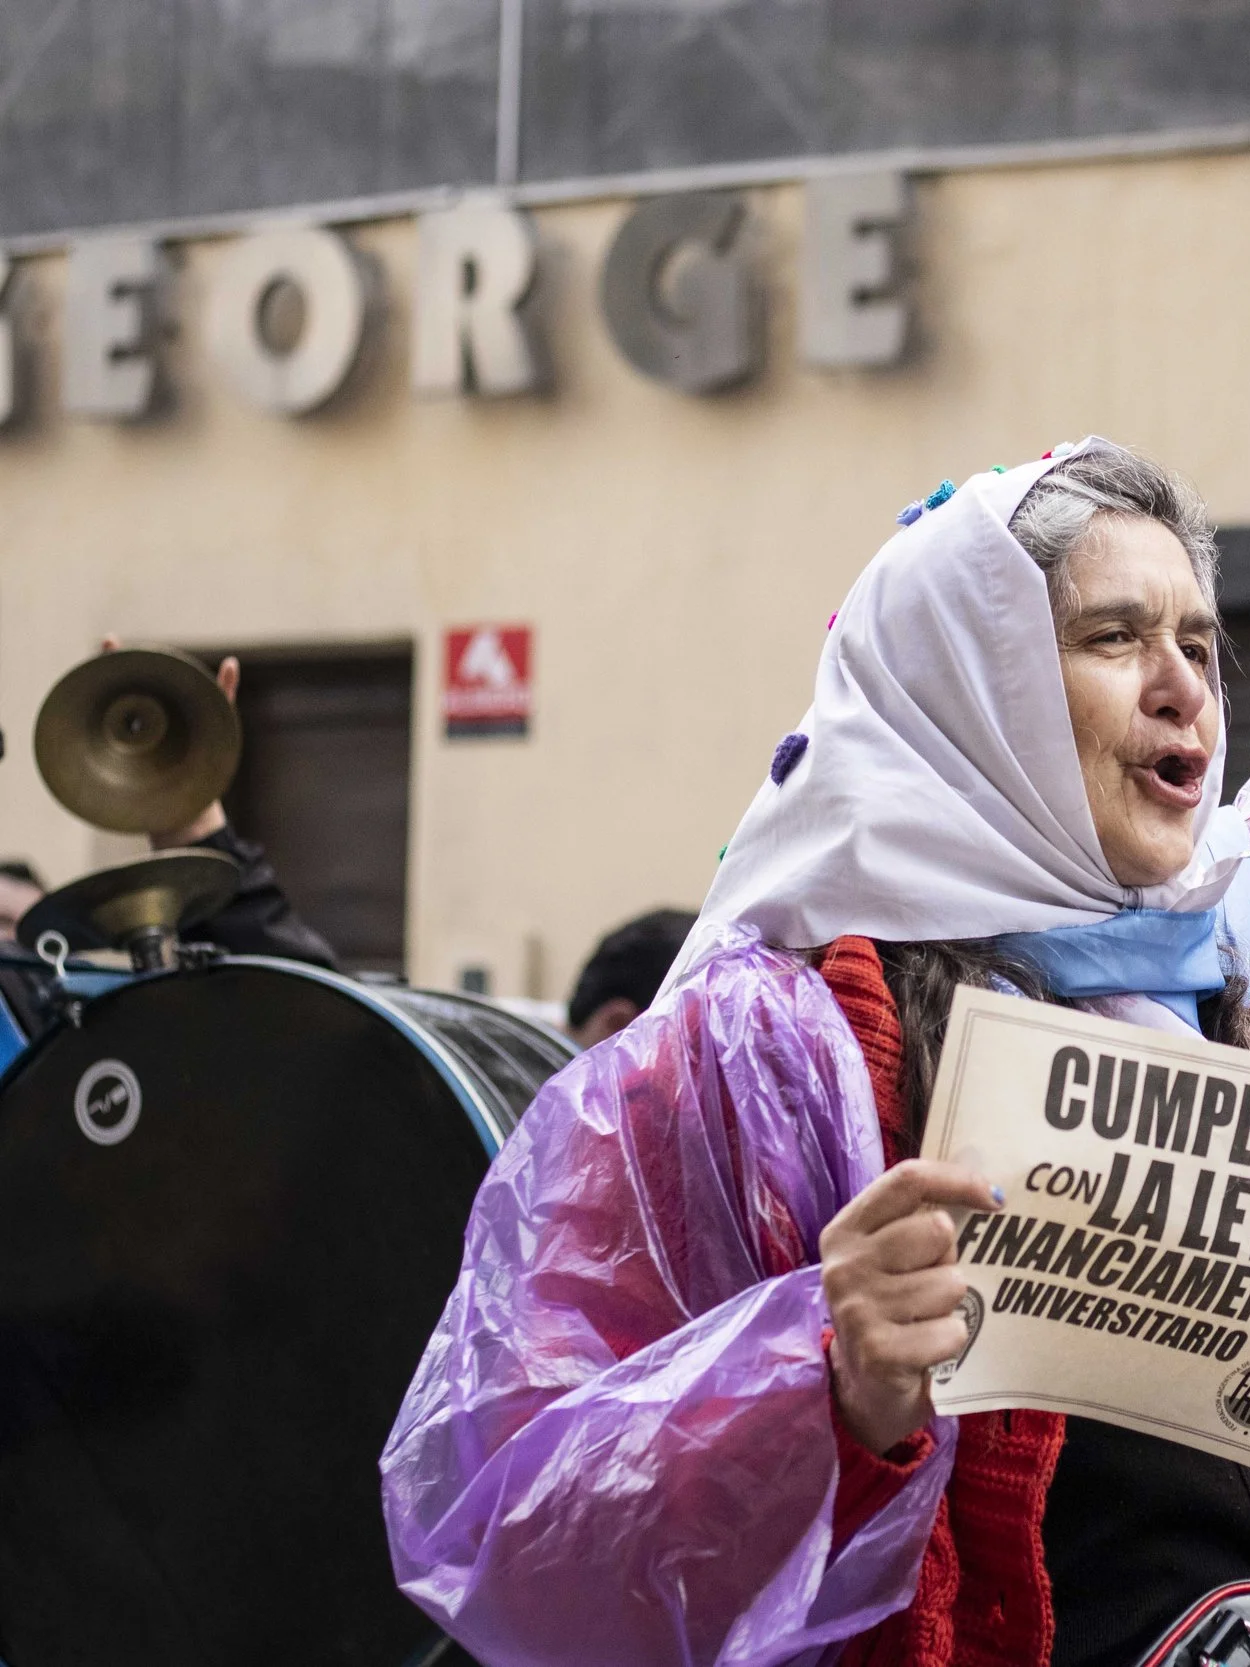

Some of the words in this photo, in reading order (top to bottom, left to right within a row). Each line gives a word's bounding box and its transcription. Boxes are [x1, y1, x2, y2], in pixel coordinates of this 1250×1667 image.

[0, 172, 908, 424] EORGE
[1025, 1162, 1102, 1205] CON
[1087, 1153, 1176, 1242] LA
[992, 1277, 1248, 1362] UNIVERSITARIO
